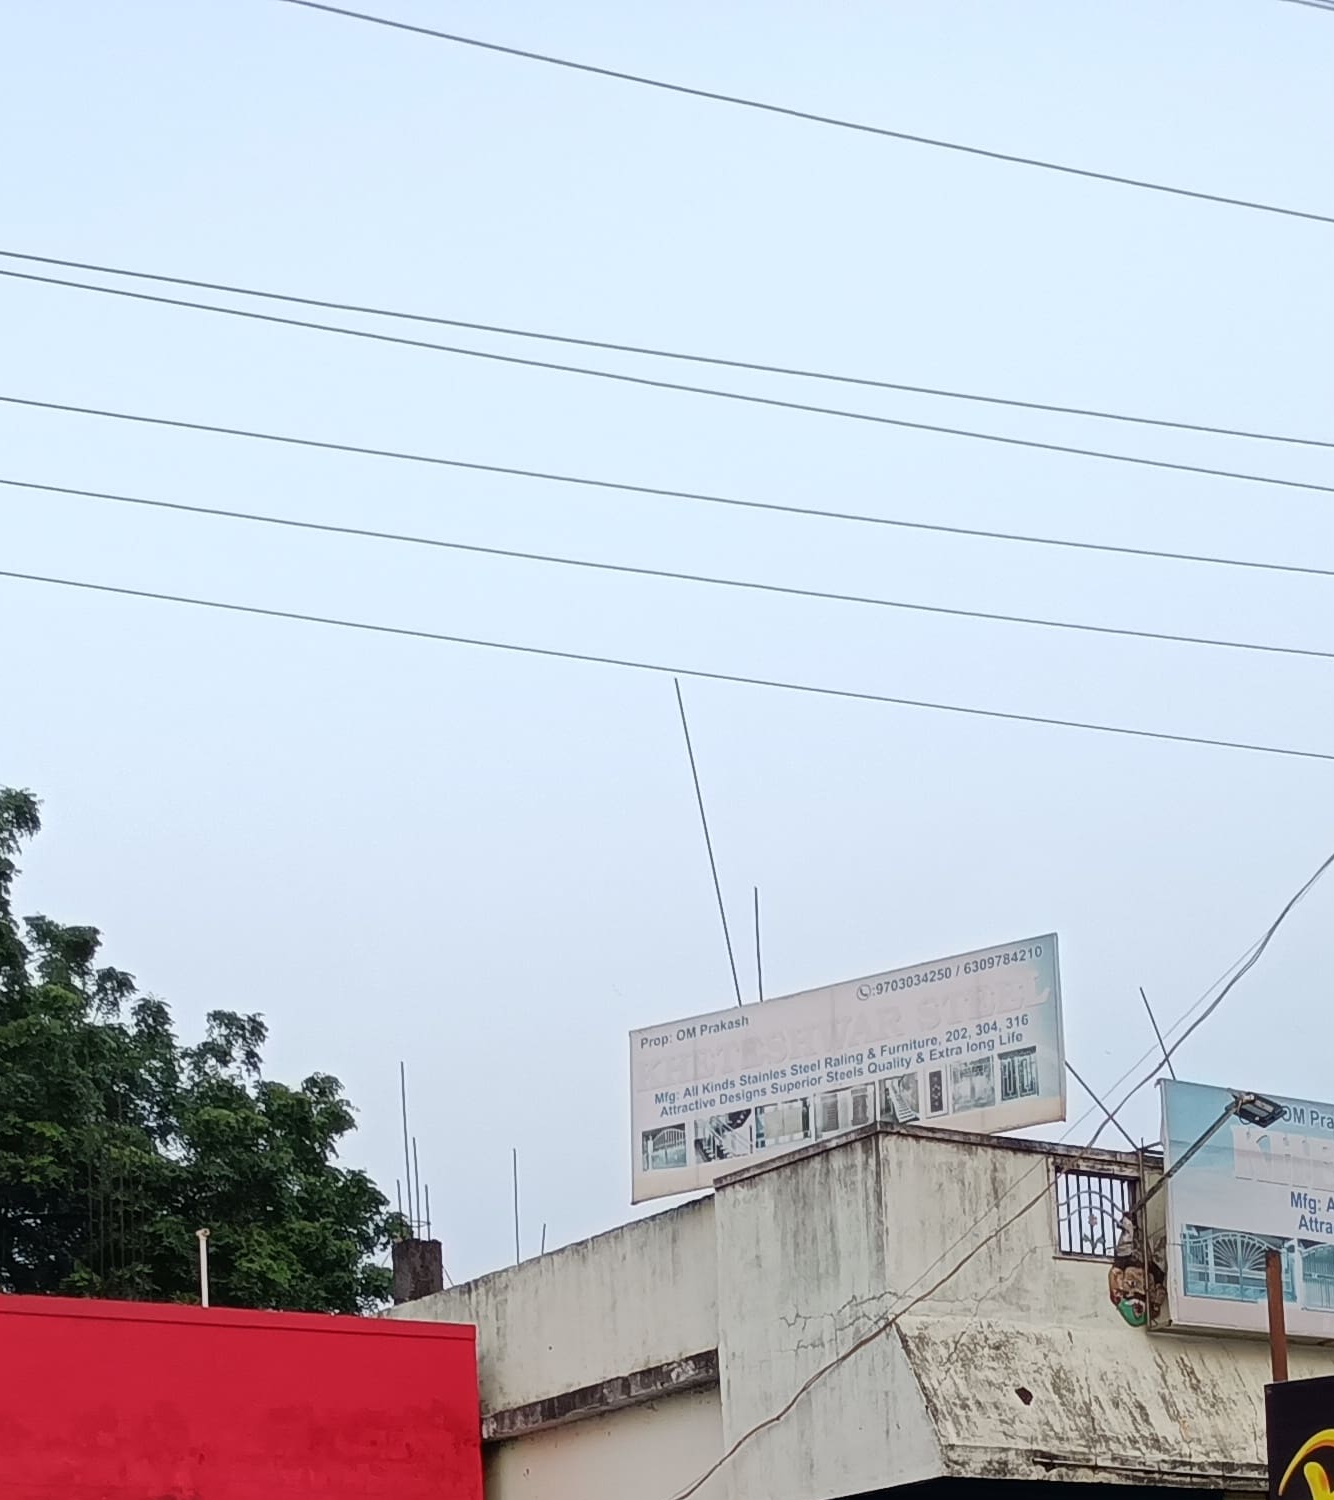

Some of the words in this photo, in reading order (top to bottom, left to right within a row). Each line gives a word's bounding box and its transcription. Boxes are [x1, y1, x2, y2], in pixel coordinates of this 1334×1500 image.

[964, 945, 1043, 974] 6309784210
[640, 1033, 673, 1049] Prop:
[676, 1026, 696, 1041] OM
[700, 1015, 749, 1036] Prakash
[654, 1090, 680, 1105] Mfg:
[683, 1084, 699, 1098] All
[702, 1078, 735, 1093] Kinds
[739, 1068, 787, 1087] Stainles
[790, 1059, 820, 1076] Steel
[824, 1049, 864, 1068] Raling
[867, 1047, 876, 1059] &
[880, 1036, 942, 1056] Furniture,
[946, 1027, 972, 1042] 202,
[976, 1020, 1002, 1036] 304,
[1006, 1014, 1029, 1030] 316
[660, 1097, 716, 1118] Attractive
[719, 1086, 767, 1105] Designs
[770, 1075, 823, 1095] Superior
[826, 1064, 864, 1083] Steels
[867, 1055, 912, 1074] Quality
[916, 1051, 925, 1063] &
[929, 1045, 963, 1061] Extra
[966, 1038, 995, 1053] long
[999, 1031, 1023, 1046] Life
[1283, 1106, 1305, 1125] OM
[1290, 1191, 1322, 1214] Mfg:
